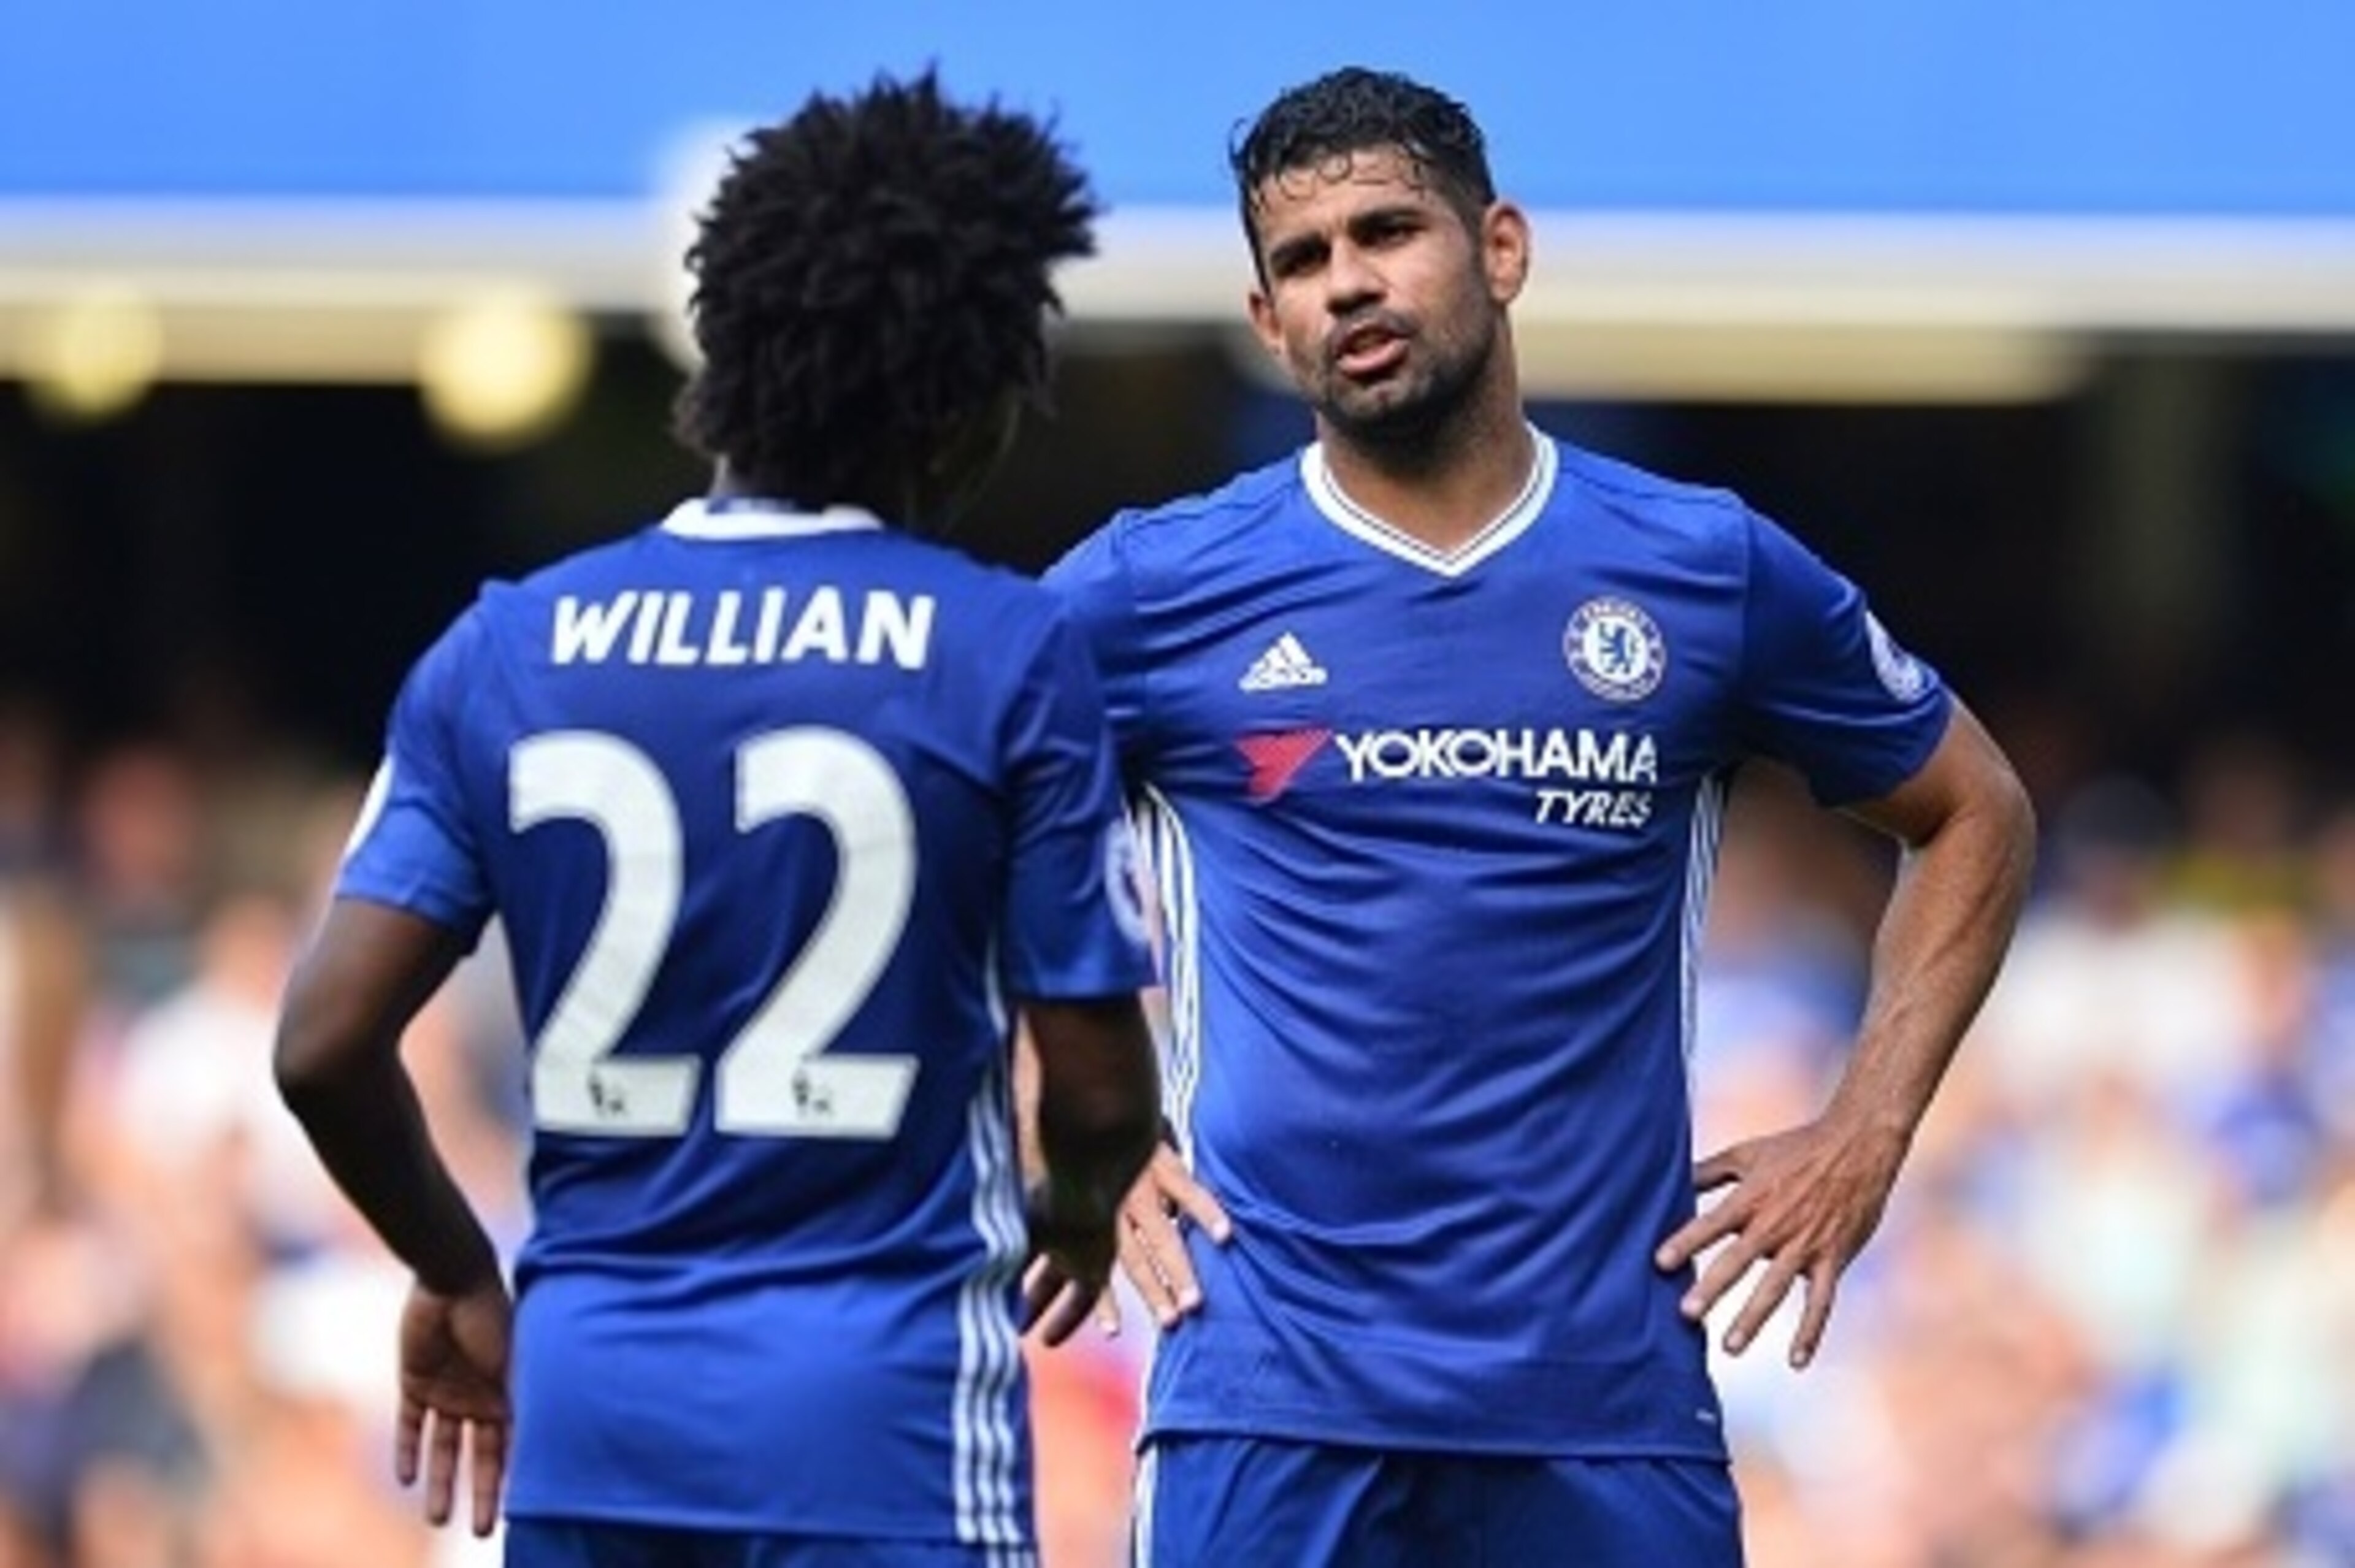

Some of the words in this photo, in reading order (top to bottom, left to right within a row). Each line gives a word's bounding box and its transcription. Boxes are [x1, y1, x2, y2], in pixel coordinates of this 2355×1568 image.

[551, 586, 935, 669] WILLIAN
[1335, 728, 1657, 784] YOKOHAMA
[1536, 789, 1650, 827] TYRES
[508, 725, 919, 1139] 22
